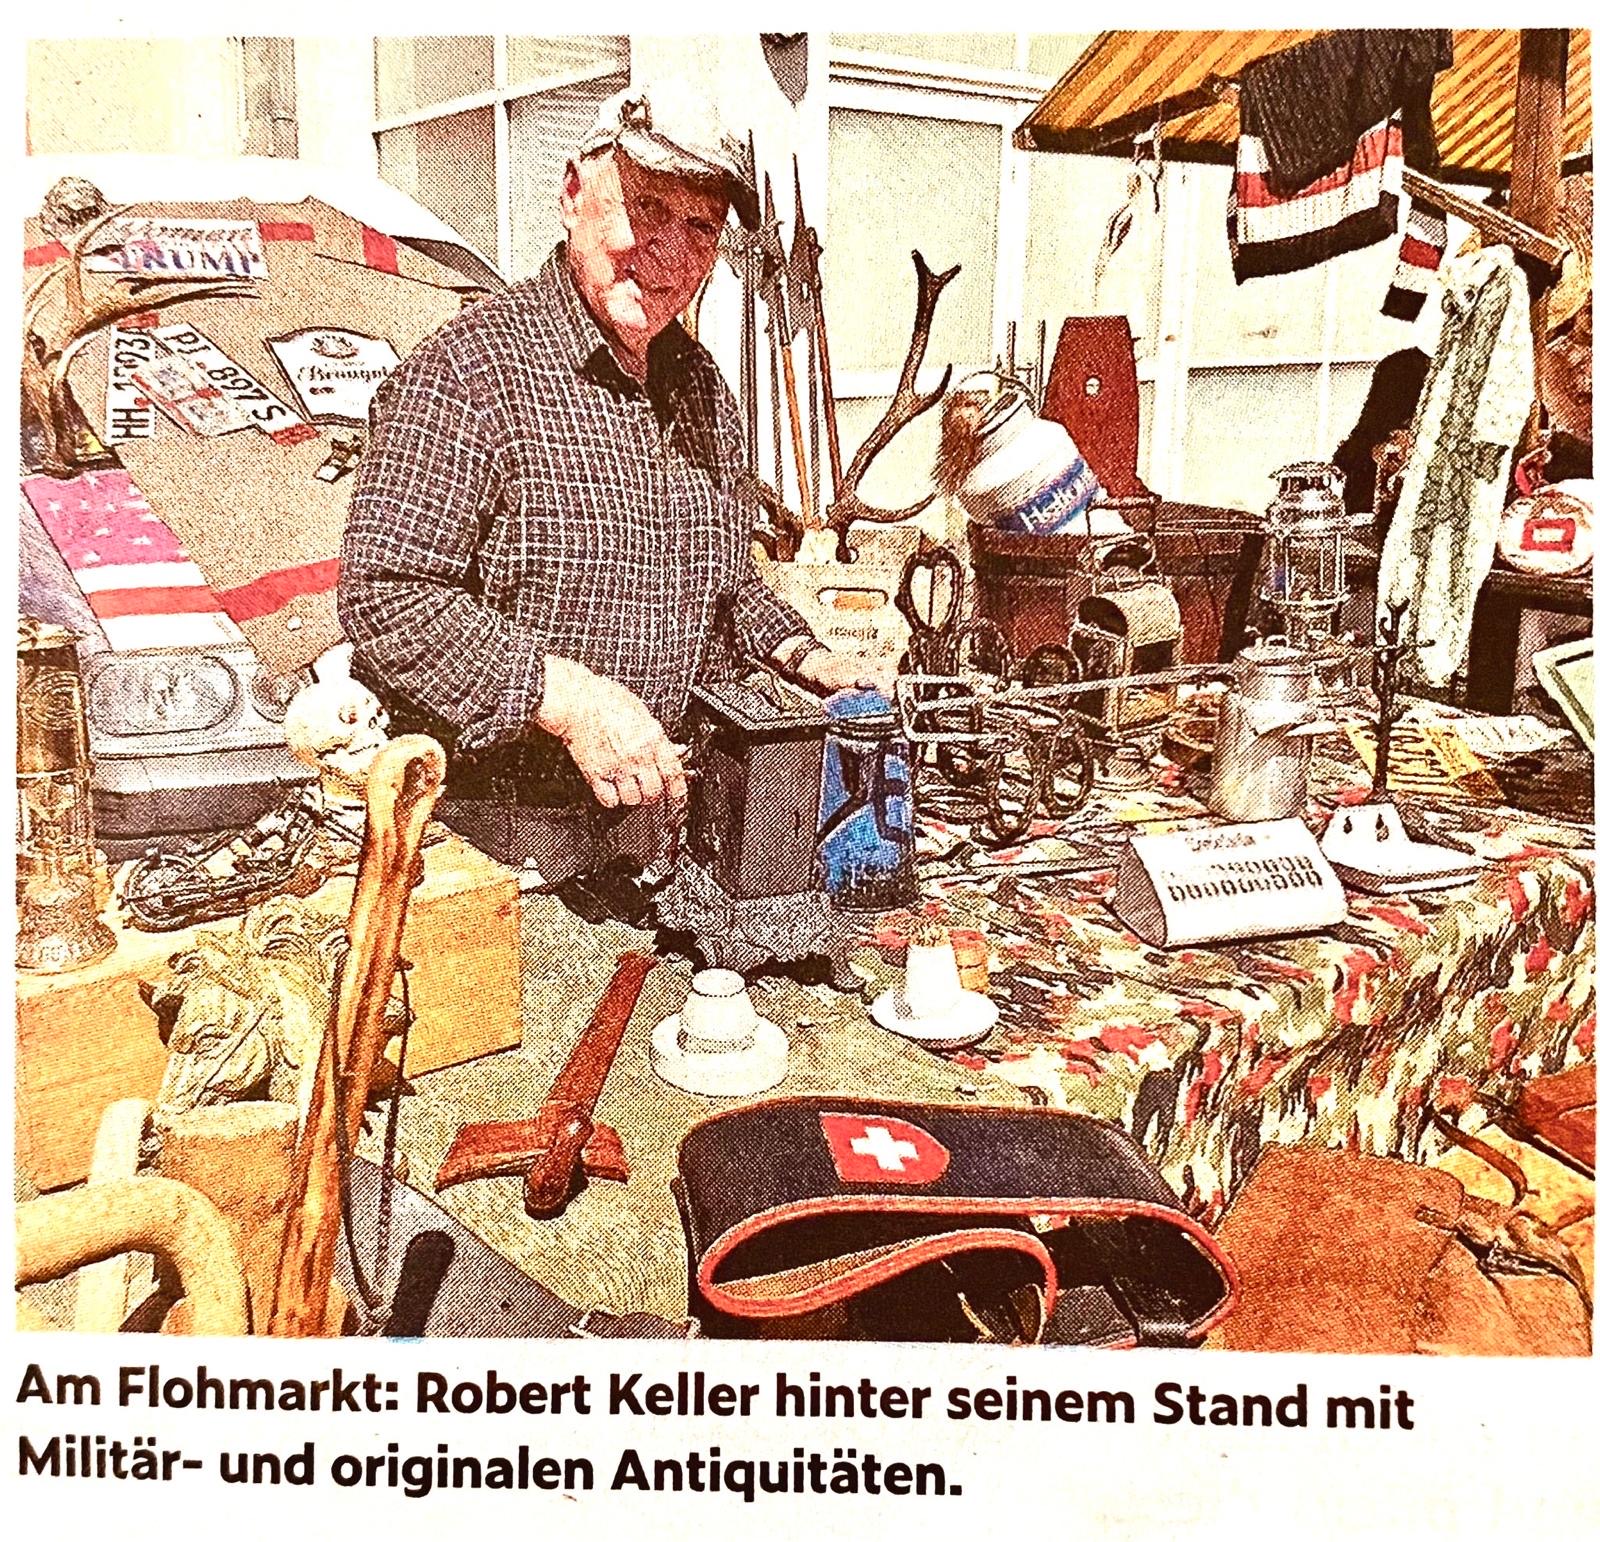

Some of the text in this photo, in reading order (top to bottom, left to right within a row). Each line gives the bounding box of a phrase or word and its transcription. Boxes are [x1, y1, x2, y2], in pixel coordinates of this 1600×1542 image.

[111, 408, 149, 438] HH
[207, 366, 269, 400] 897
[252, 405, 286, 421] S
[16, 1364, 1415, 1431] Am Flohmarkt: Robert Keller hinter seinem Stand mit
[18, 1434, 963, 1503] Militär- und originalen Antiquitäten.
